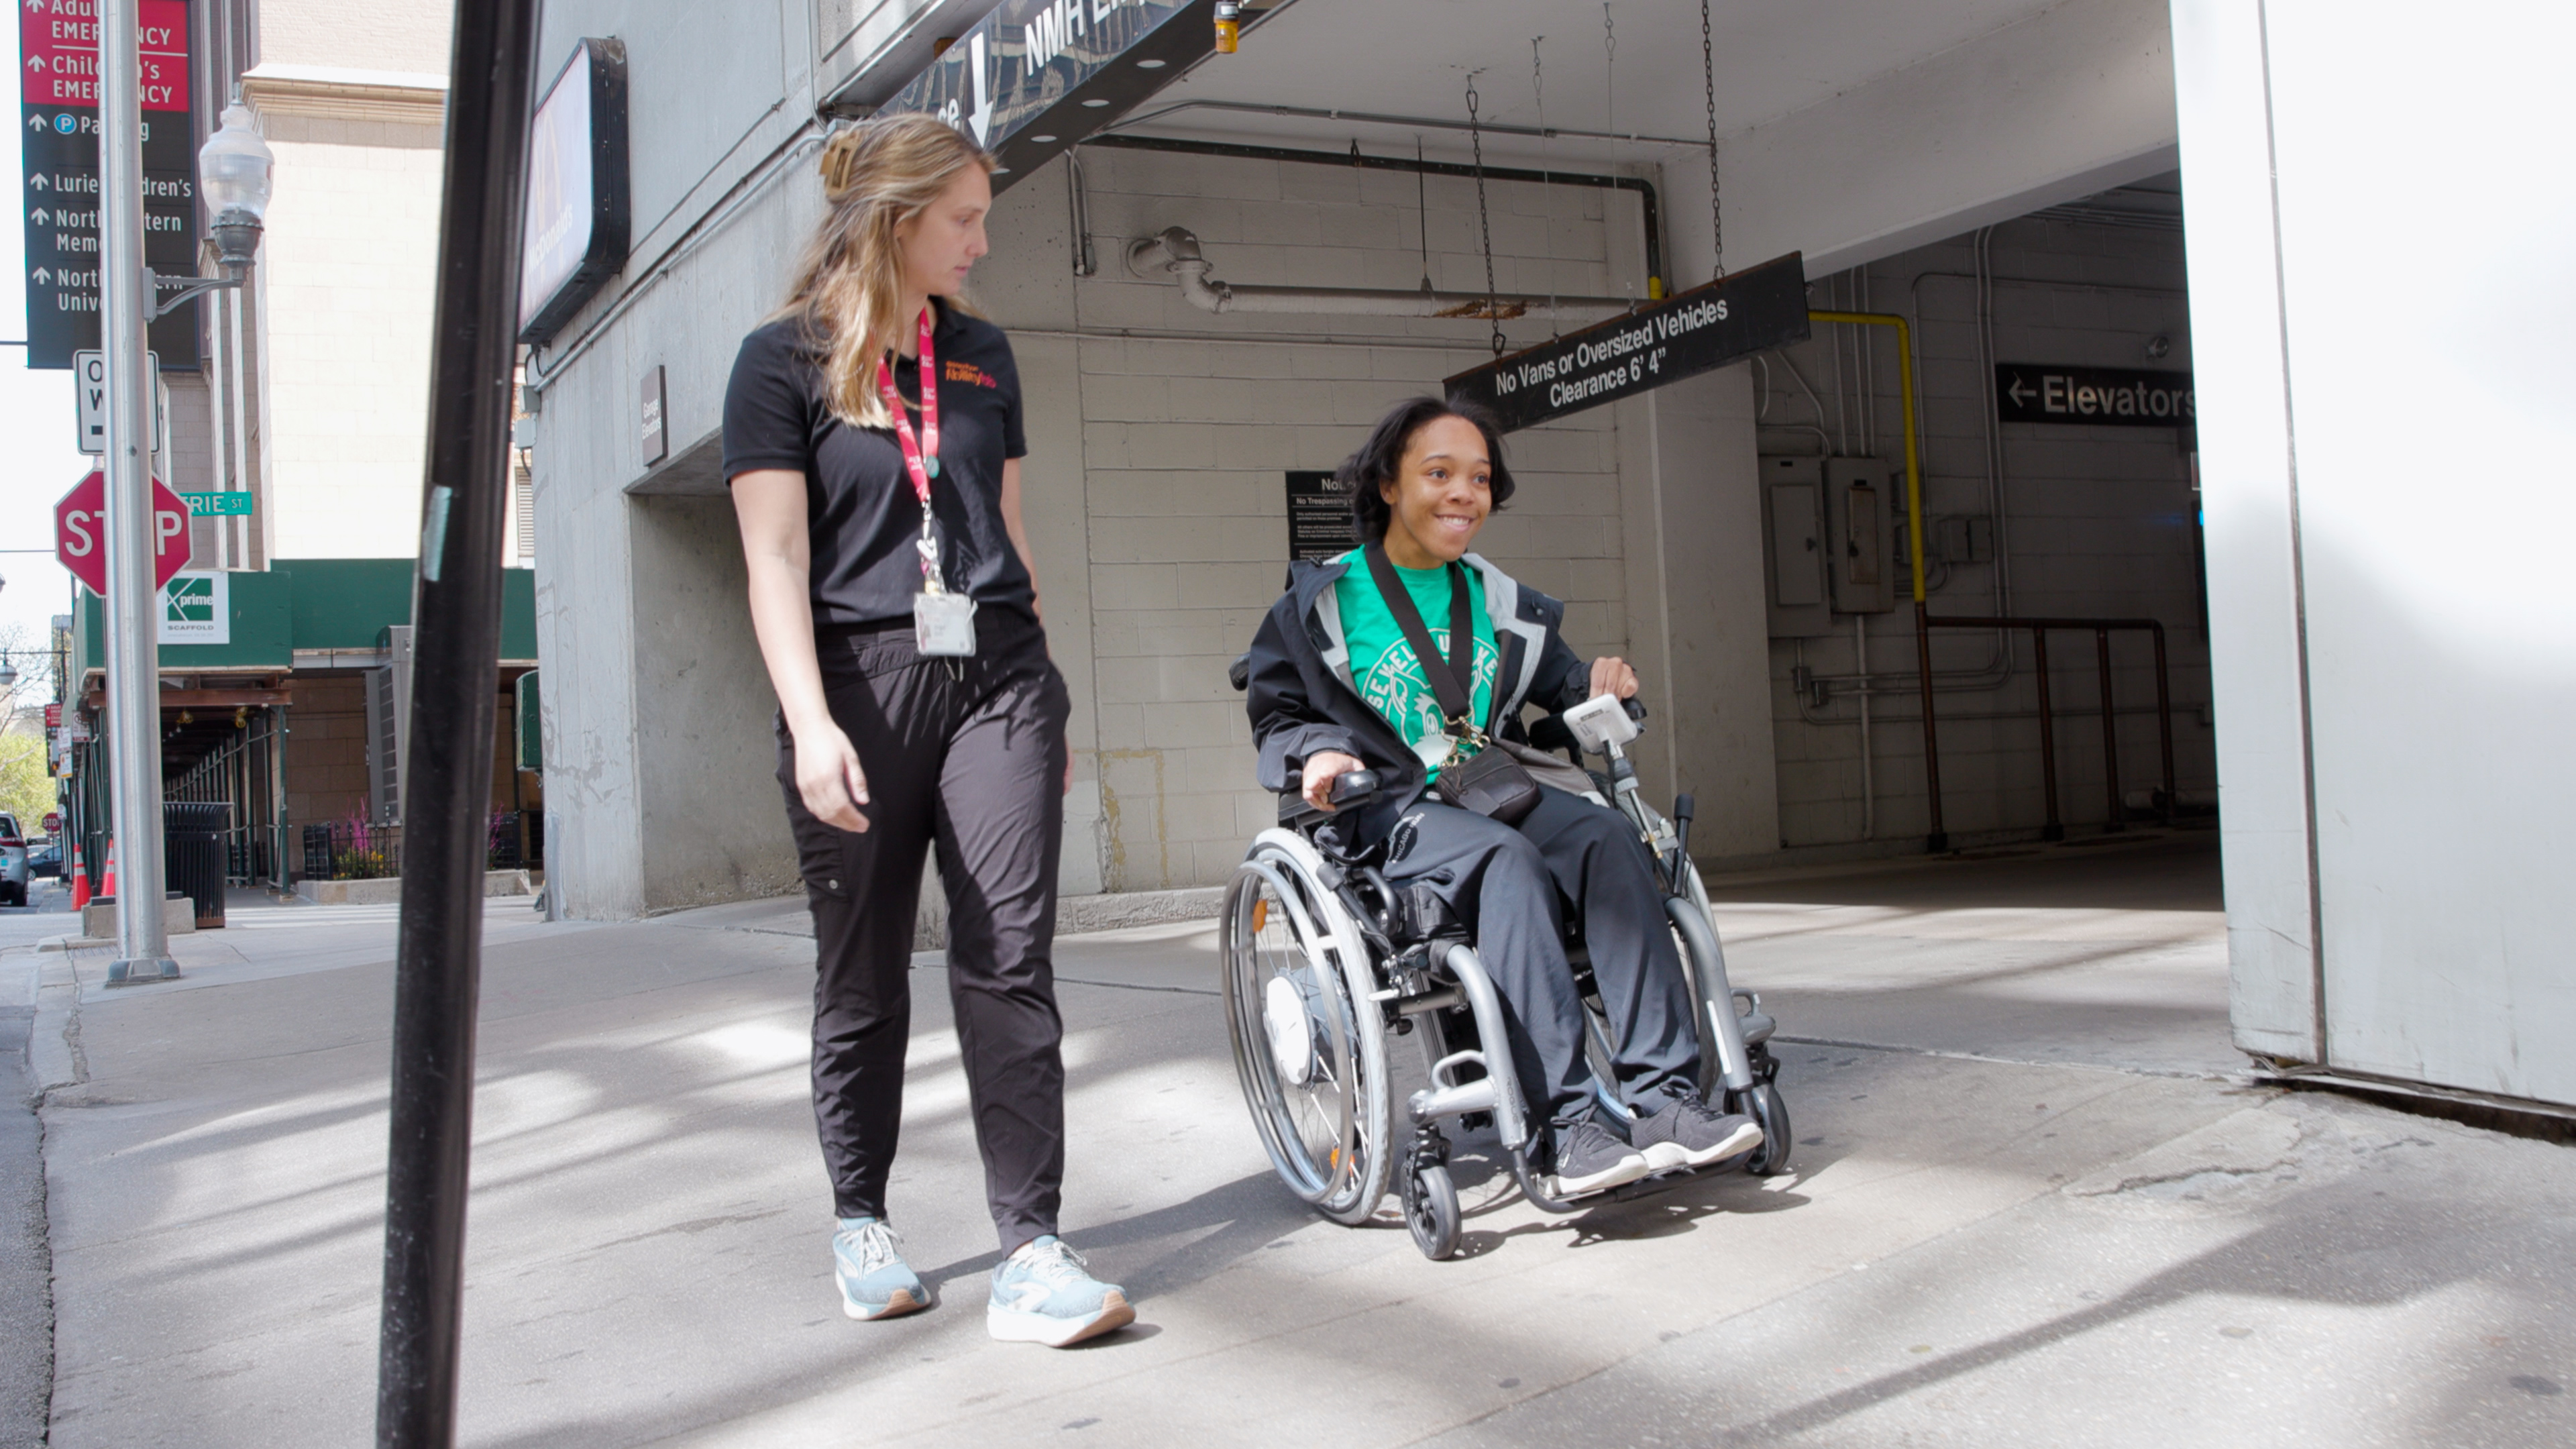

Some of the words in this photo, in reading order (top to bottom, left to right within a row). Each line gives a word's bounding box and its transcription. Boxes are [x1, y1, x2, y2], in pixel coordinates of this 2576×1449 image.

[51, 0, 99, 17] Adul
[56, 174, 98, 193] Lurie
[1496, 372, 1516, 396] No
[1518, 360, 1556, 388] Vans
[1558, 353, 1574, 374] or
[1577, 319, 1653, 368] Oversized
[1656, 299, 1728, 339] Vehicles
[1550, 367, 1626, 407] Clearance
[2043, 375, 2194, 418] Elevators
[643, 398, 658, 419] Garage
[642, 417, 661, 440] Elevators
[231, 498, 242, 508] ST
[1308, 497, 1348, 506] Trespassing
[65, 510, 182, 557] SP
[180, 593, 214, 608] prime
[43, 818, 59, 827] STO
